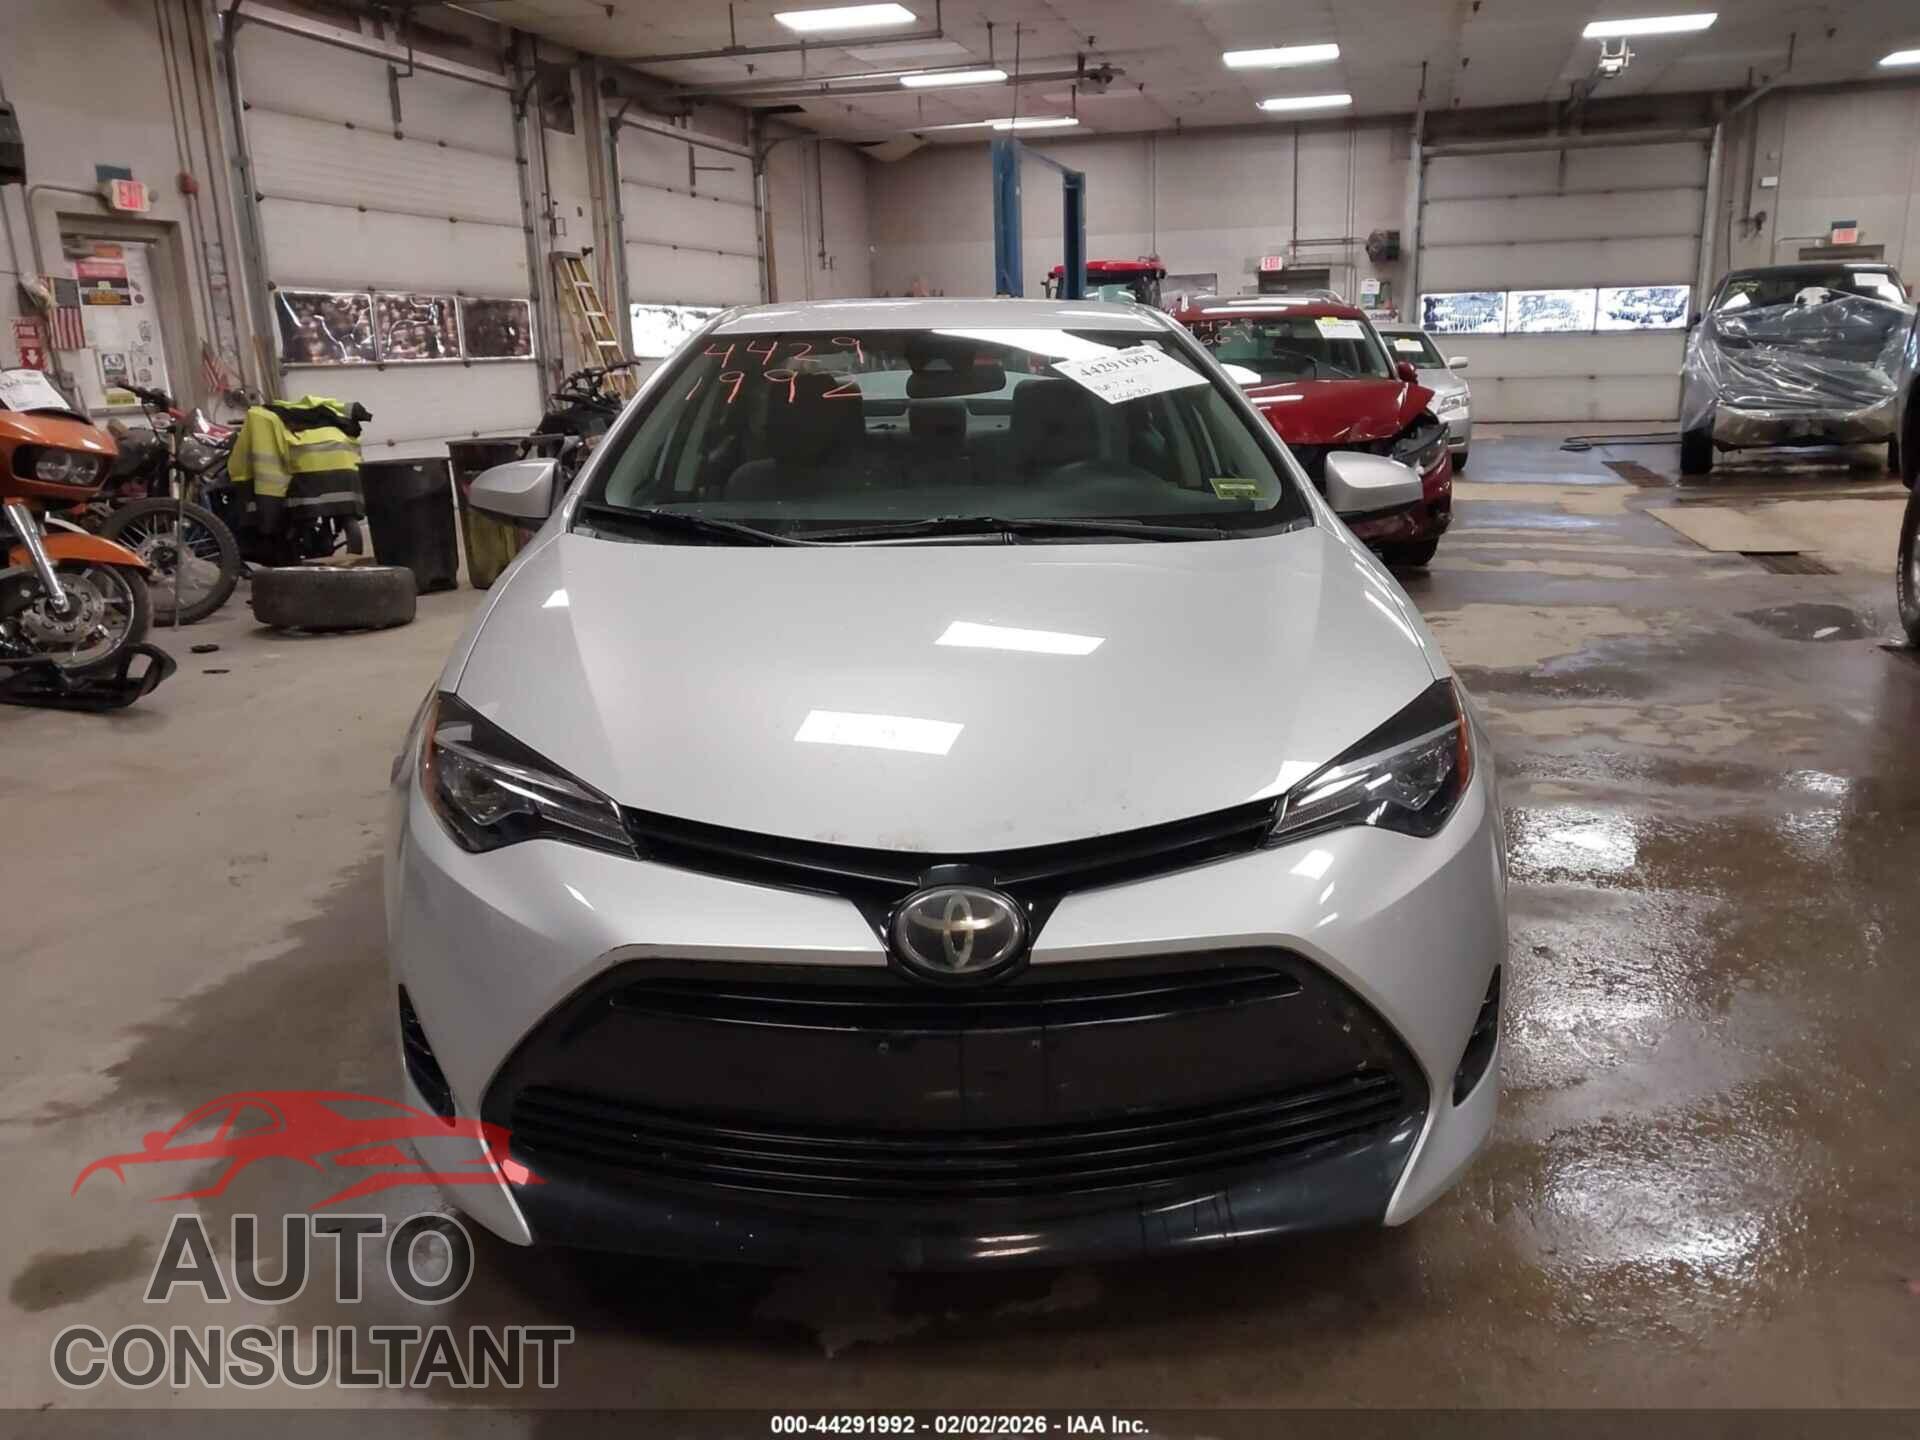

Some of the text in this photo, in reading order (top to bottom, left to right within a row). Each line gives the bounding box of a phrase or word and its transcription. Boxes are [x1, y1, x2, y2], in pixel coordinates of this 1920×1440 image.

[703, 336, 865, 368] 4429
[1080, 354, 1160, 377] 44291992
[685, 368, 866, 404] 1992
